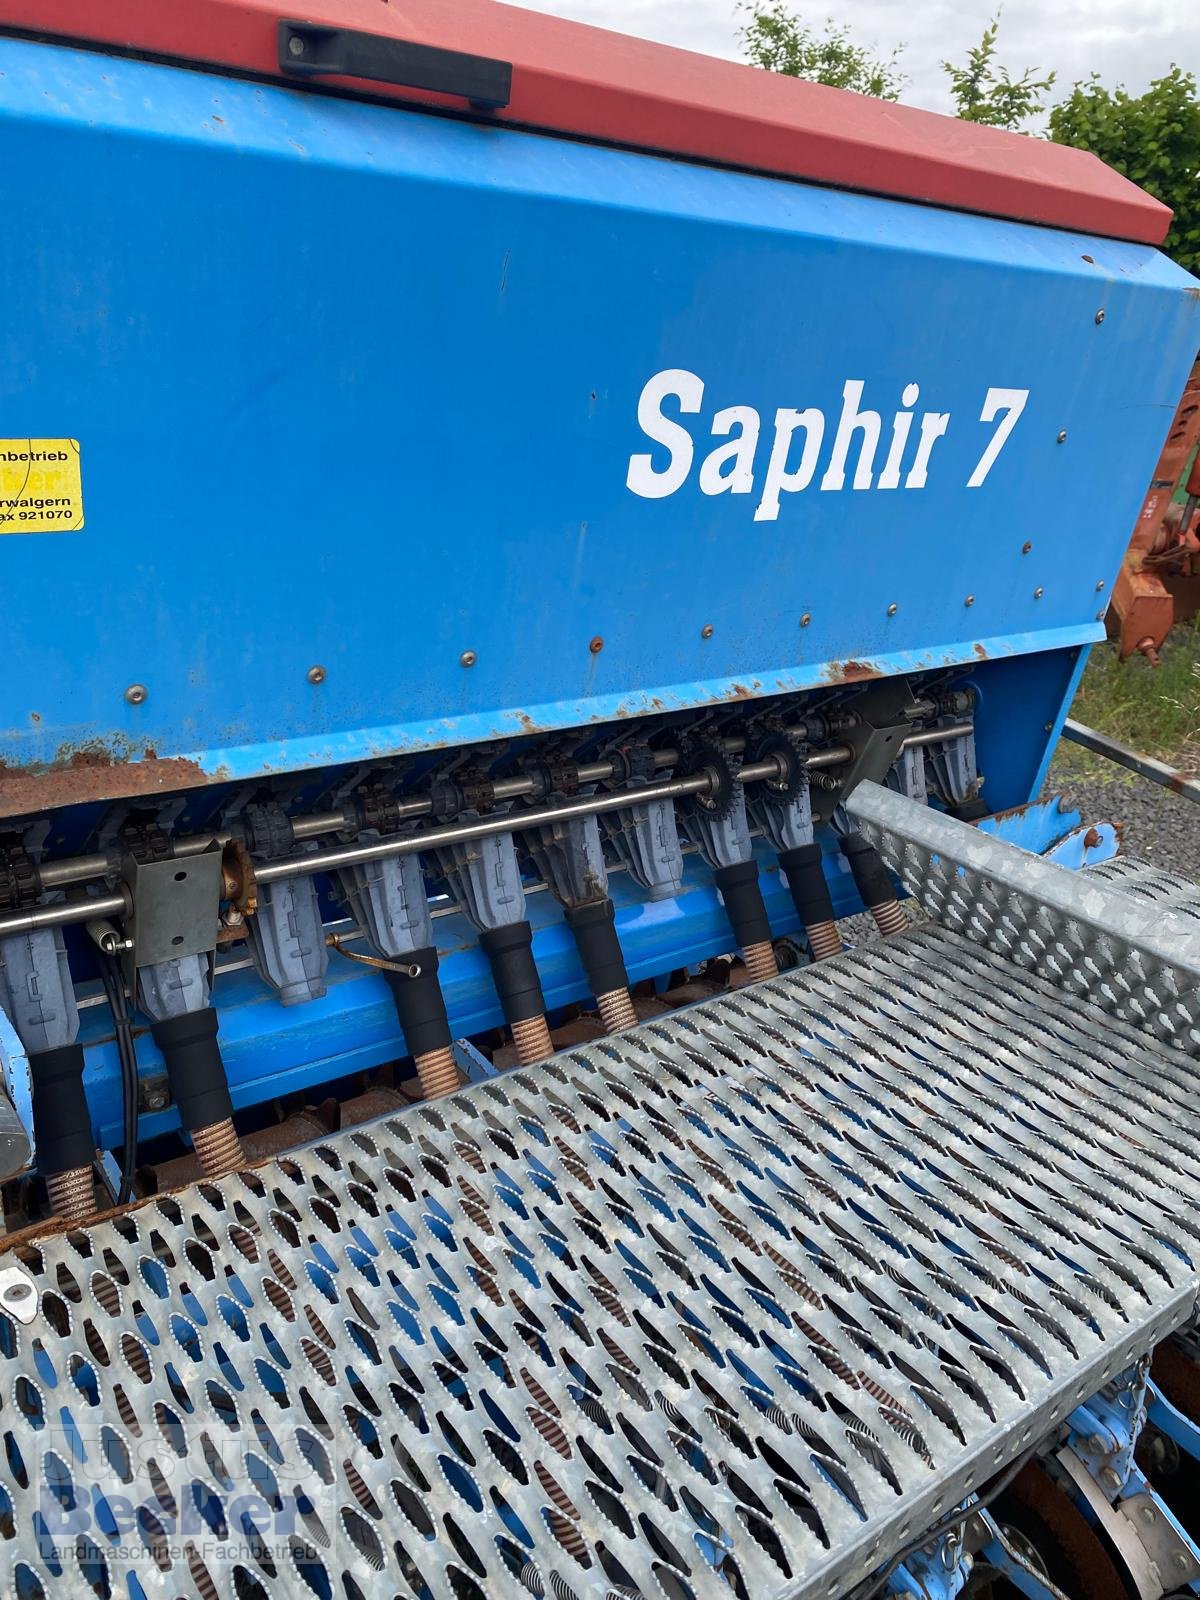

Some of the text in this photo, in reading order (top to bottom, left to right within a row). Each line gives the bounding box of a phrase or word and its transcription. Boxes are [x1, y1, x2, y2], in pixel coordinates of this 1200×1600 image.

[626, 368, 1030, 521] Saphir 7
[18, 510, 73, 521] 921070
